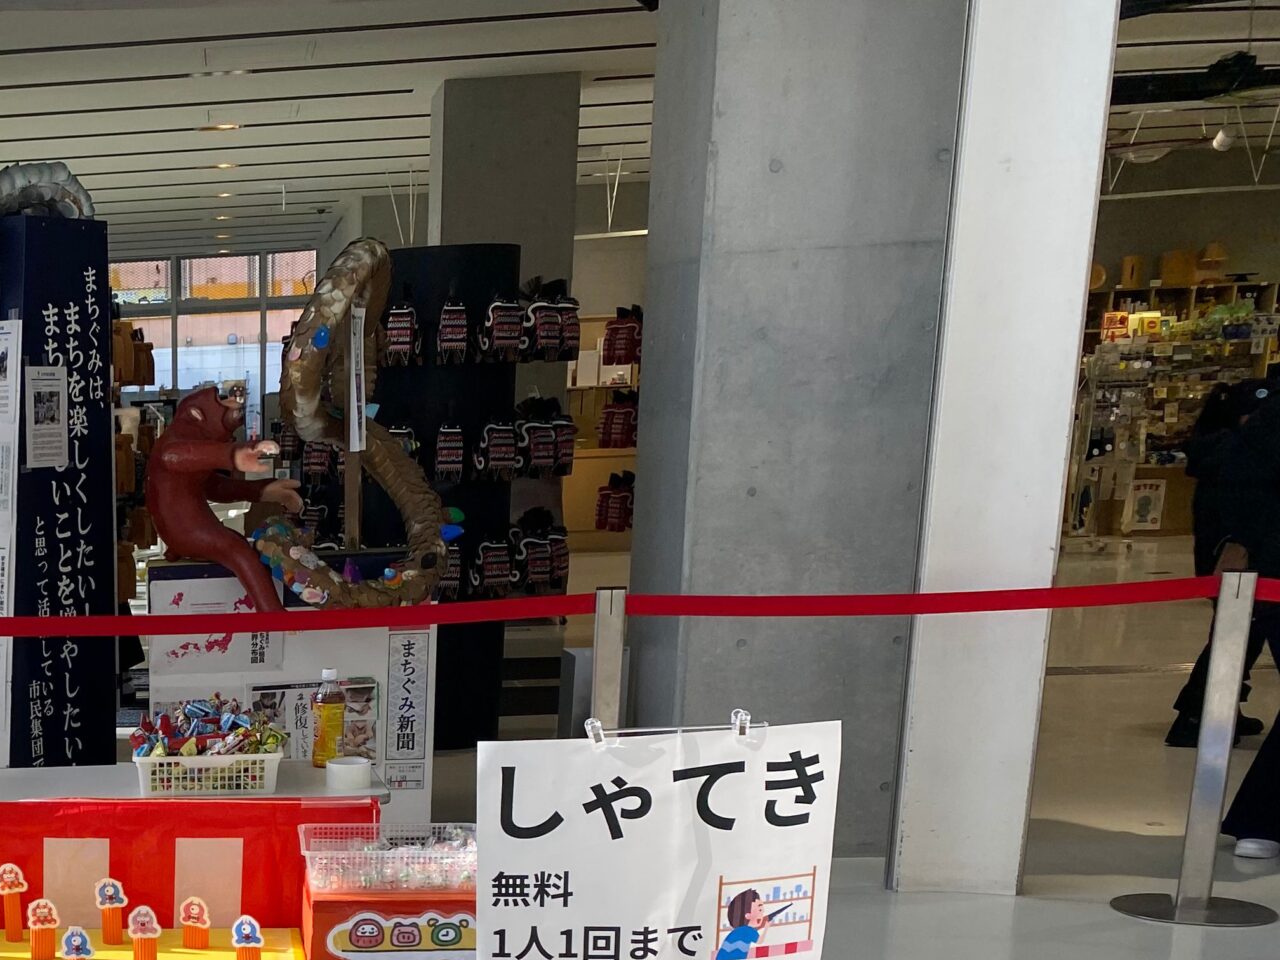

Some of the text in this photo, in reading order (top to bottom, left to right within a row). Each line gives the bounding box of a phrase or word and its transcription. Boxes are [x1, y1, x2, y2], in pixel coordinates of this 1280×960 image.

[83, 266, 105, 409] まちぐみは、
[41, 302, 83, 767] まちいことをやしたい
[33, 516, 55, 717] と思って活している
[395, 639, 417, 752] まちぐみ新聞
[500, 750, 824, 840] しゃてき
[491, 870, 574, 908] 無料
